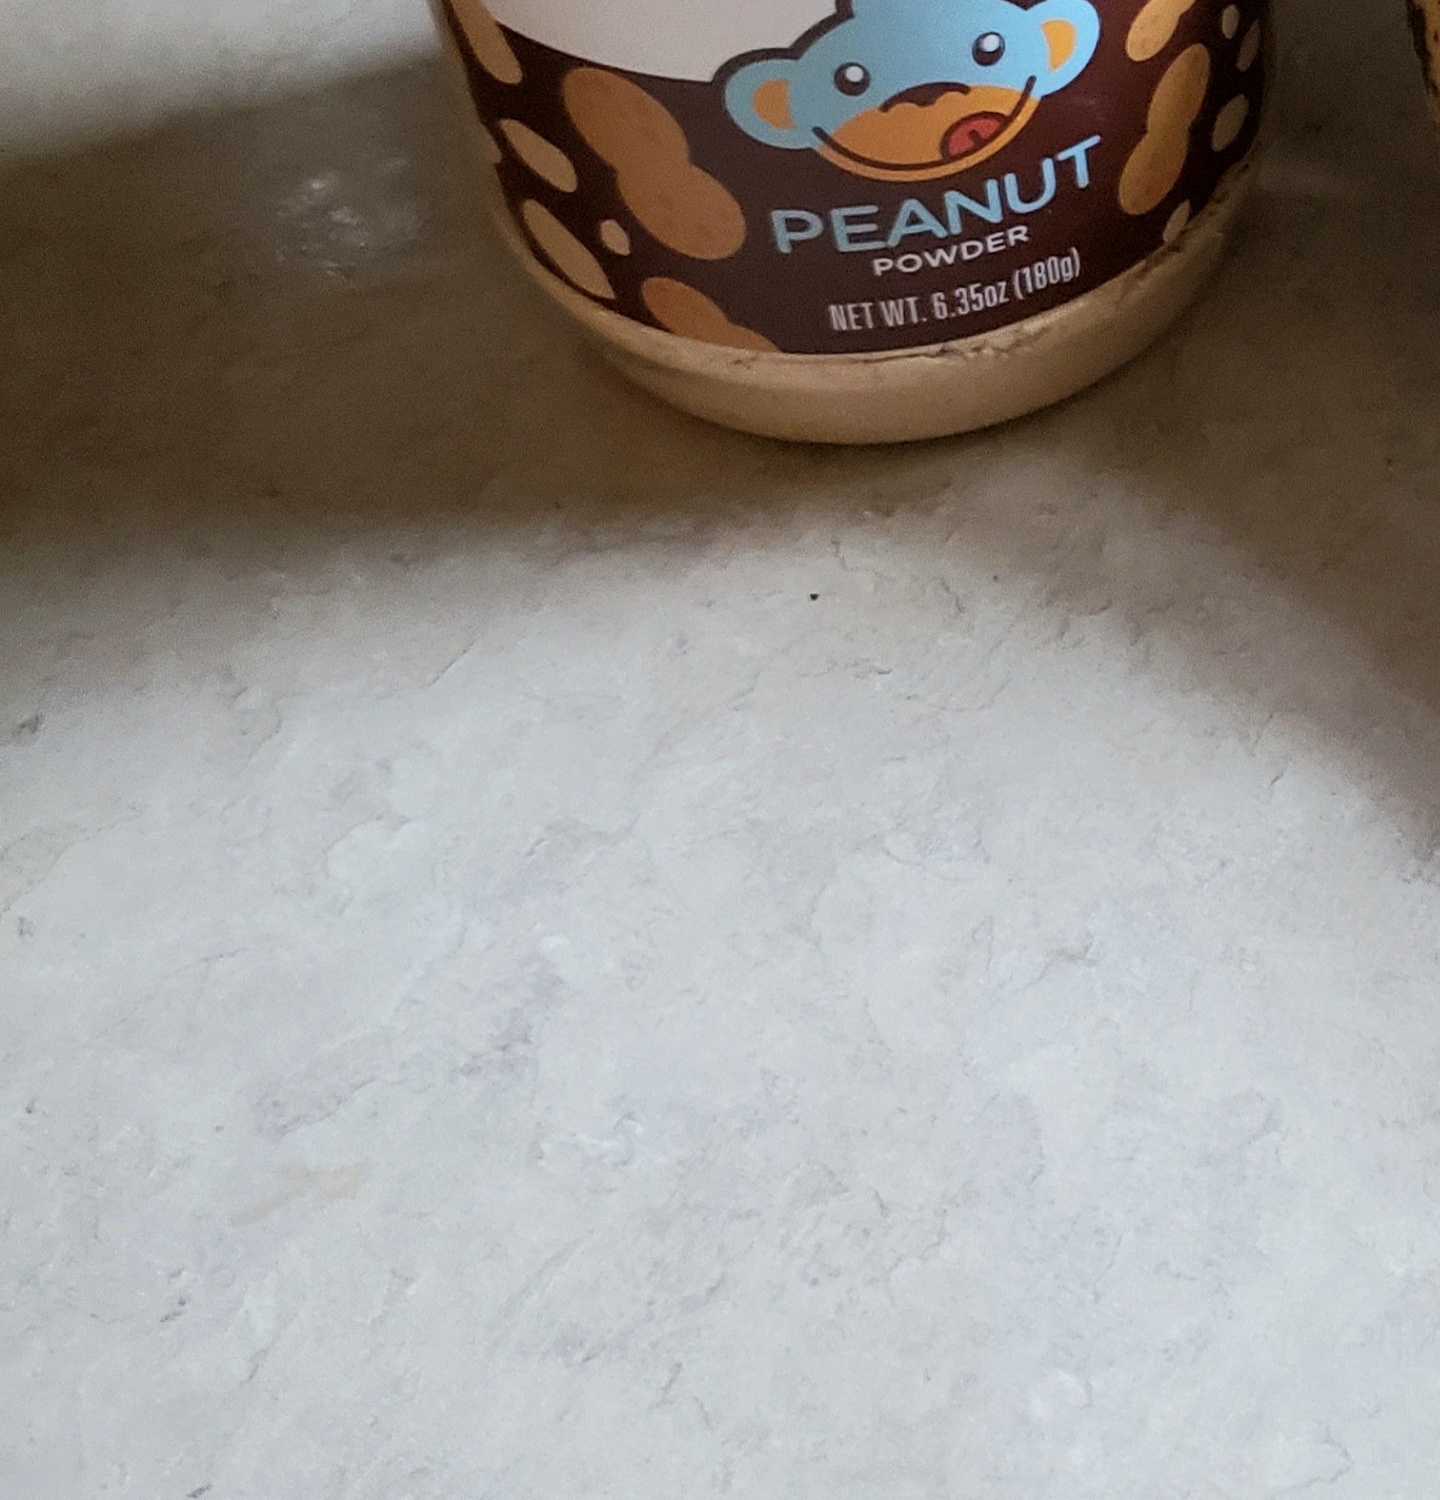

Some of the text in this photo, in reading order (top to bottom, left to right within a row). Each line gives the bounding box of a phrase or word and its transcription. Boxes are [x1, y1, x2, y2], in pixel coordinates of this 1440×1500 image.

[771, 135, 1101, 254] PEANUT
[828, 247, 1082, 332] NET WT. 6.35oz (180g)
[872, 225, 1031, 277] POWDER
